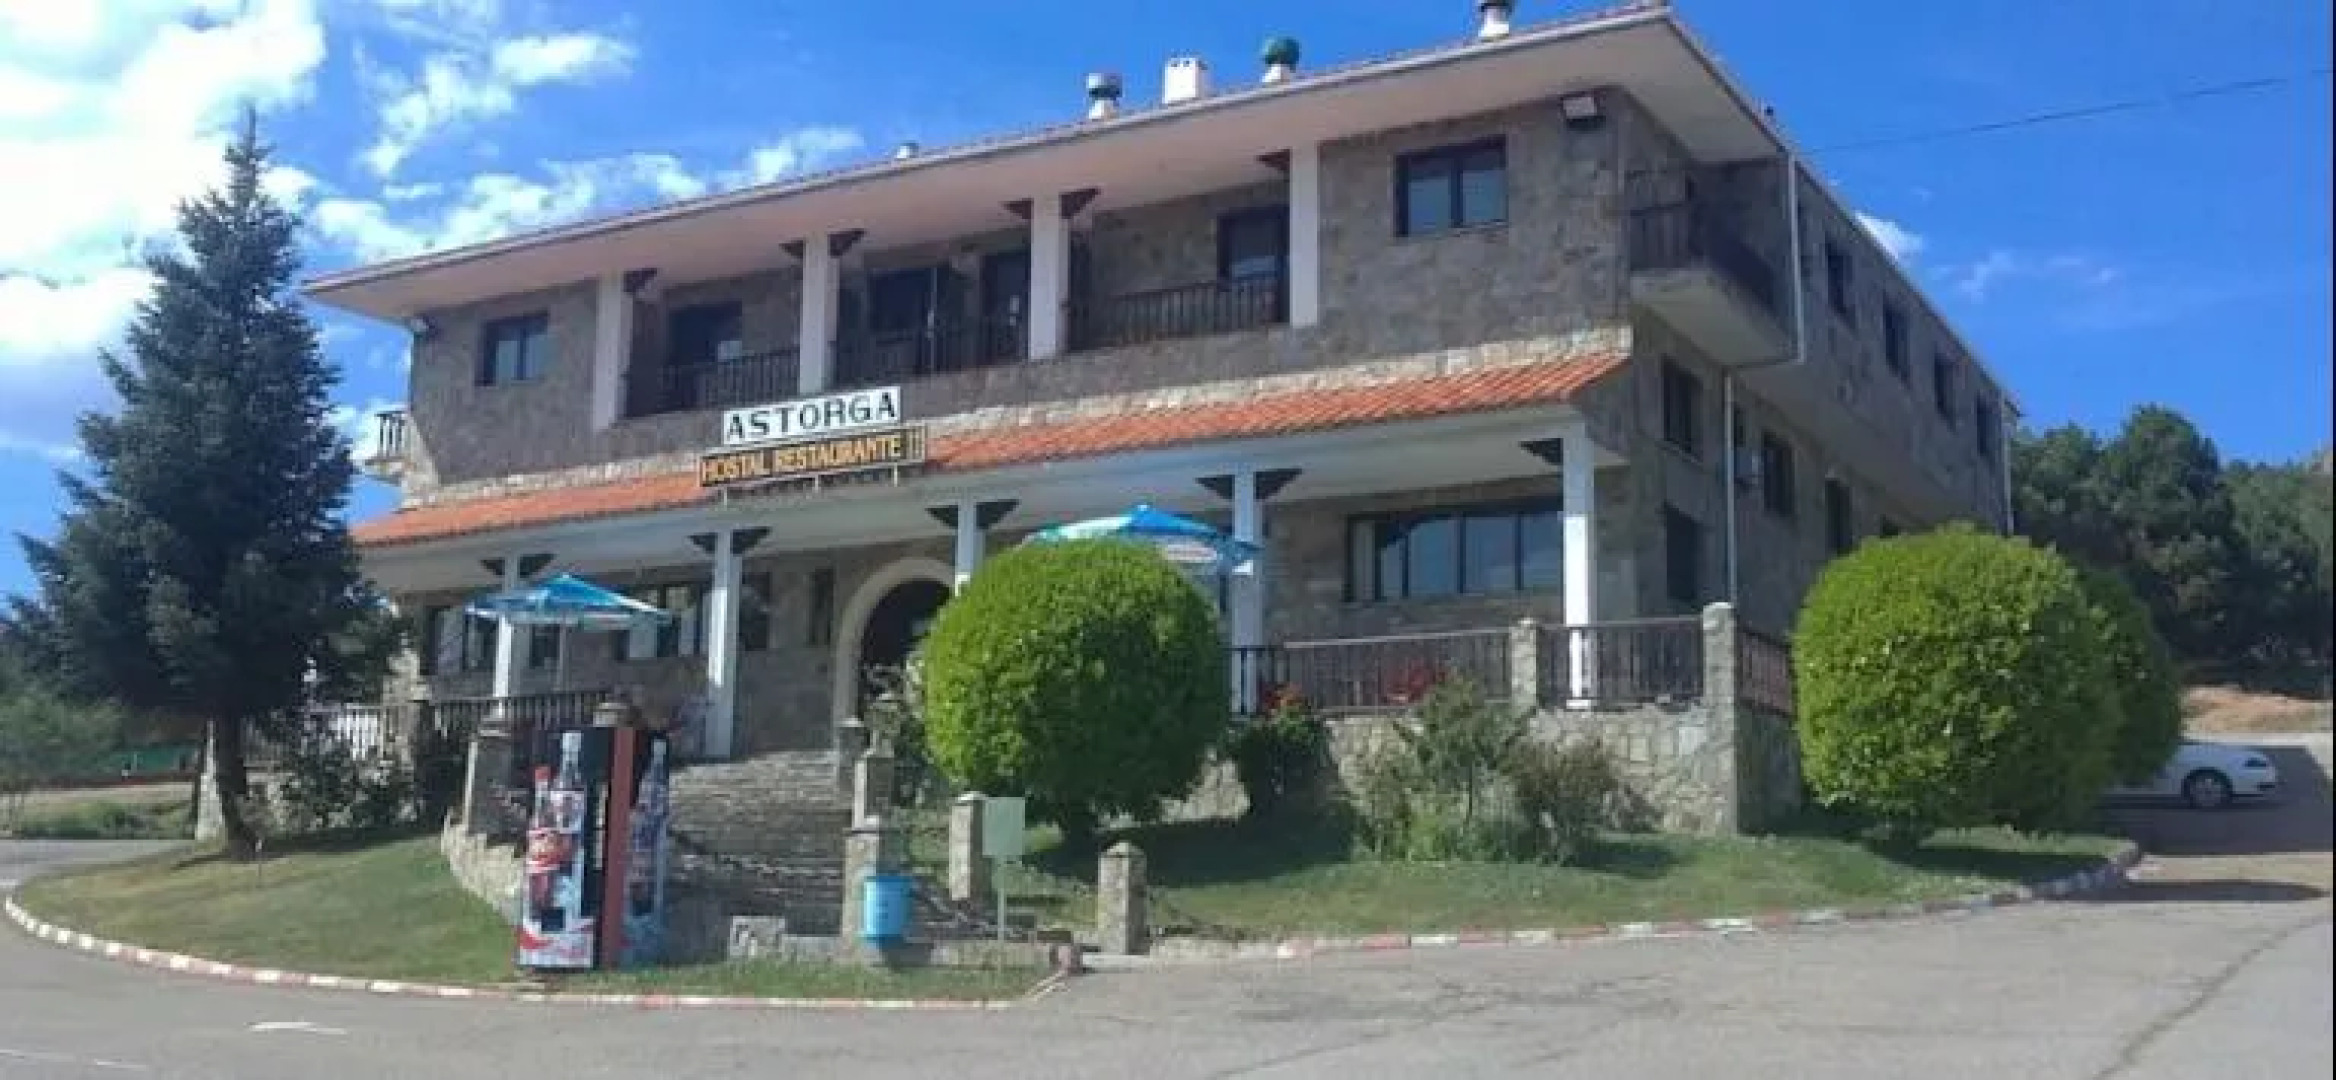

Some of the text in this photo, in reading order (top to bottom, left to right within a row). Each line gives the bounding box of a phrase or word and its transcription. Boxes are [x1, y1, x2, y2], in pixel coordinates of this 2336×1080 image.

[727, 391, 896, 440] ASTORGA
[702, 434, 903, 484] HOSTAL RESTAURANTE
